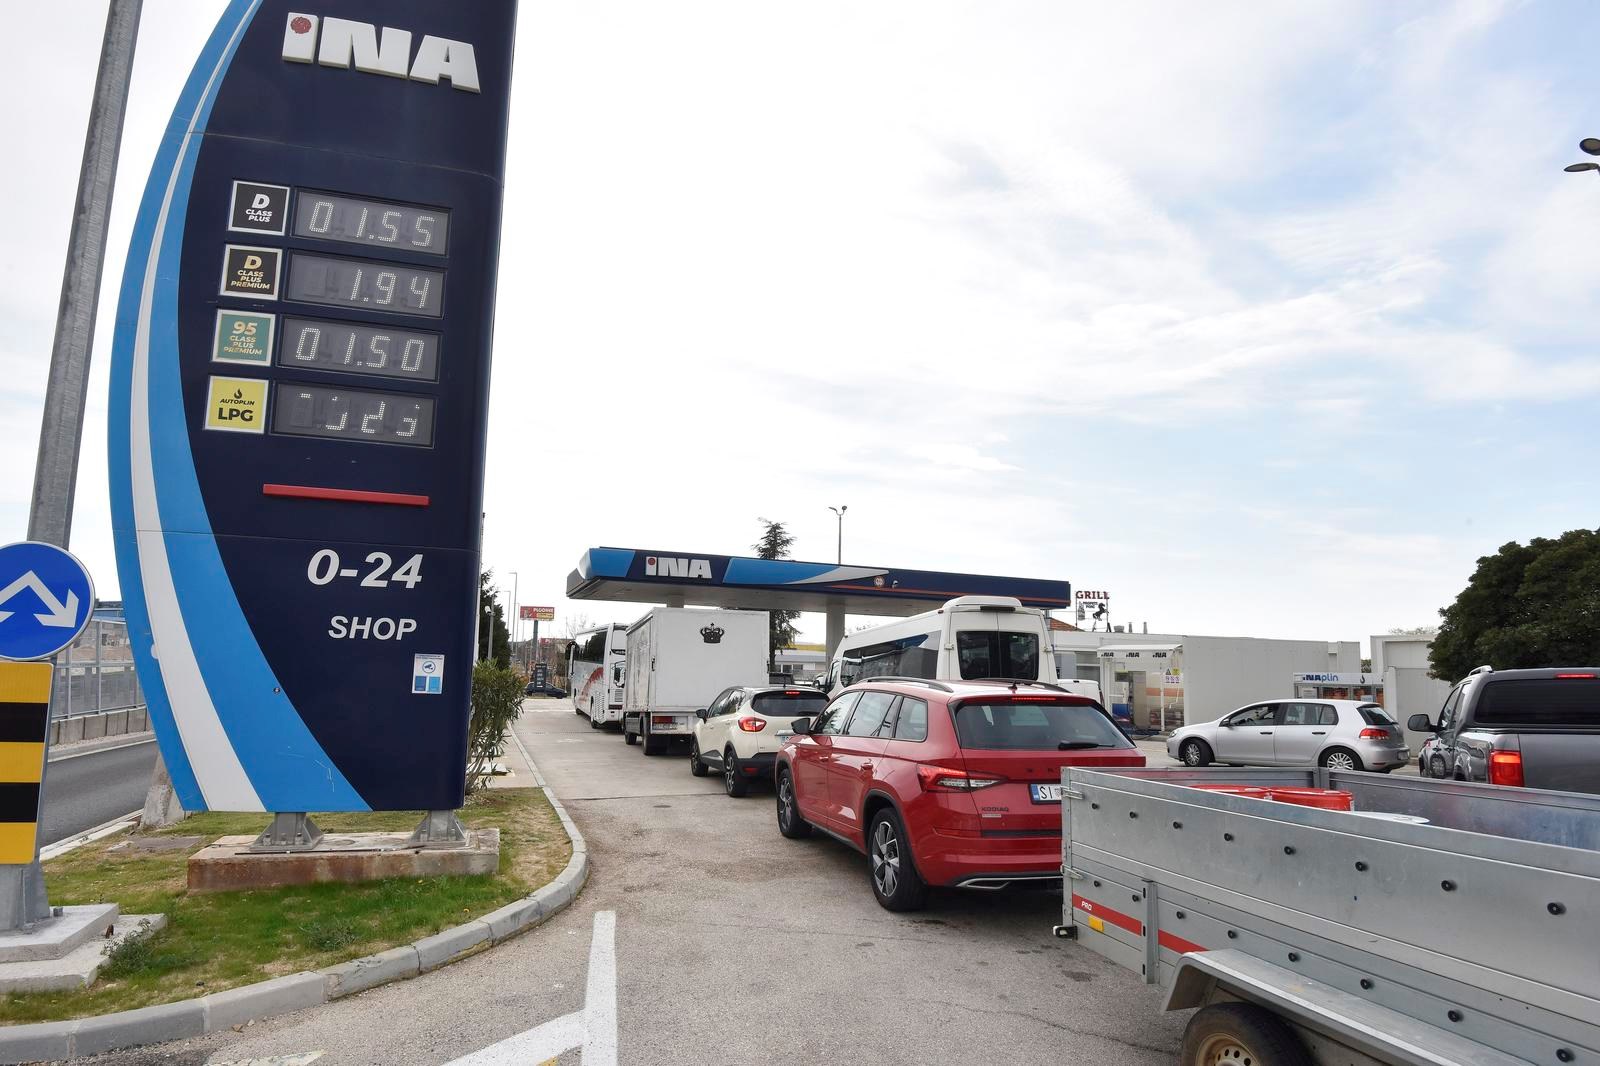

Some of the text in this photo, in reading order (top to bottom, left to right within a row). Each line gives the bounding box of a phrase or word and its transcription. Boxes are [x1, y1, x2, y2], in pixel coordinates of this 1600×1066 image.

[251, 193, 271, 209] D
[245, 208, 273, 217] CLASS
[248, 215, 271, 223] PLUS
[243, 255, 263, 270] D
[237, 269, 264, 278] CLASS
[240, 275, 262, 283] PLUS
[230, 280, 271, 290] PREMIUM
[351, 269, 430, 308] 1.94
[232, 321, 258, 336] 95
[229, 335, 257, 343] CLASS
[233, 341, 255, 349] PLUS
[223, 346, 263, 355] PREMIUM
[219, 398, 256, 406] AUTOPLIN
[217, 407, 254, 422] LPG
[307, 548, 424, 589] 0-24
[1075, 590, 1110, 600] GRILL
[328, 615, 417, 641] SHOP
[1081, 900, 1093, 911] PRO
